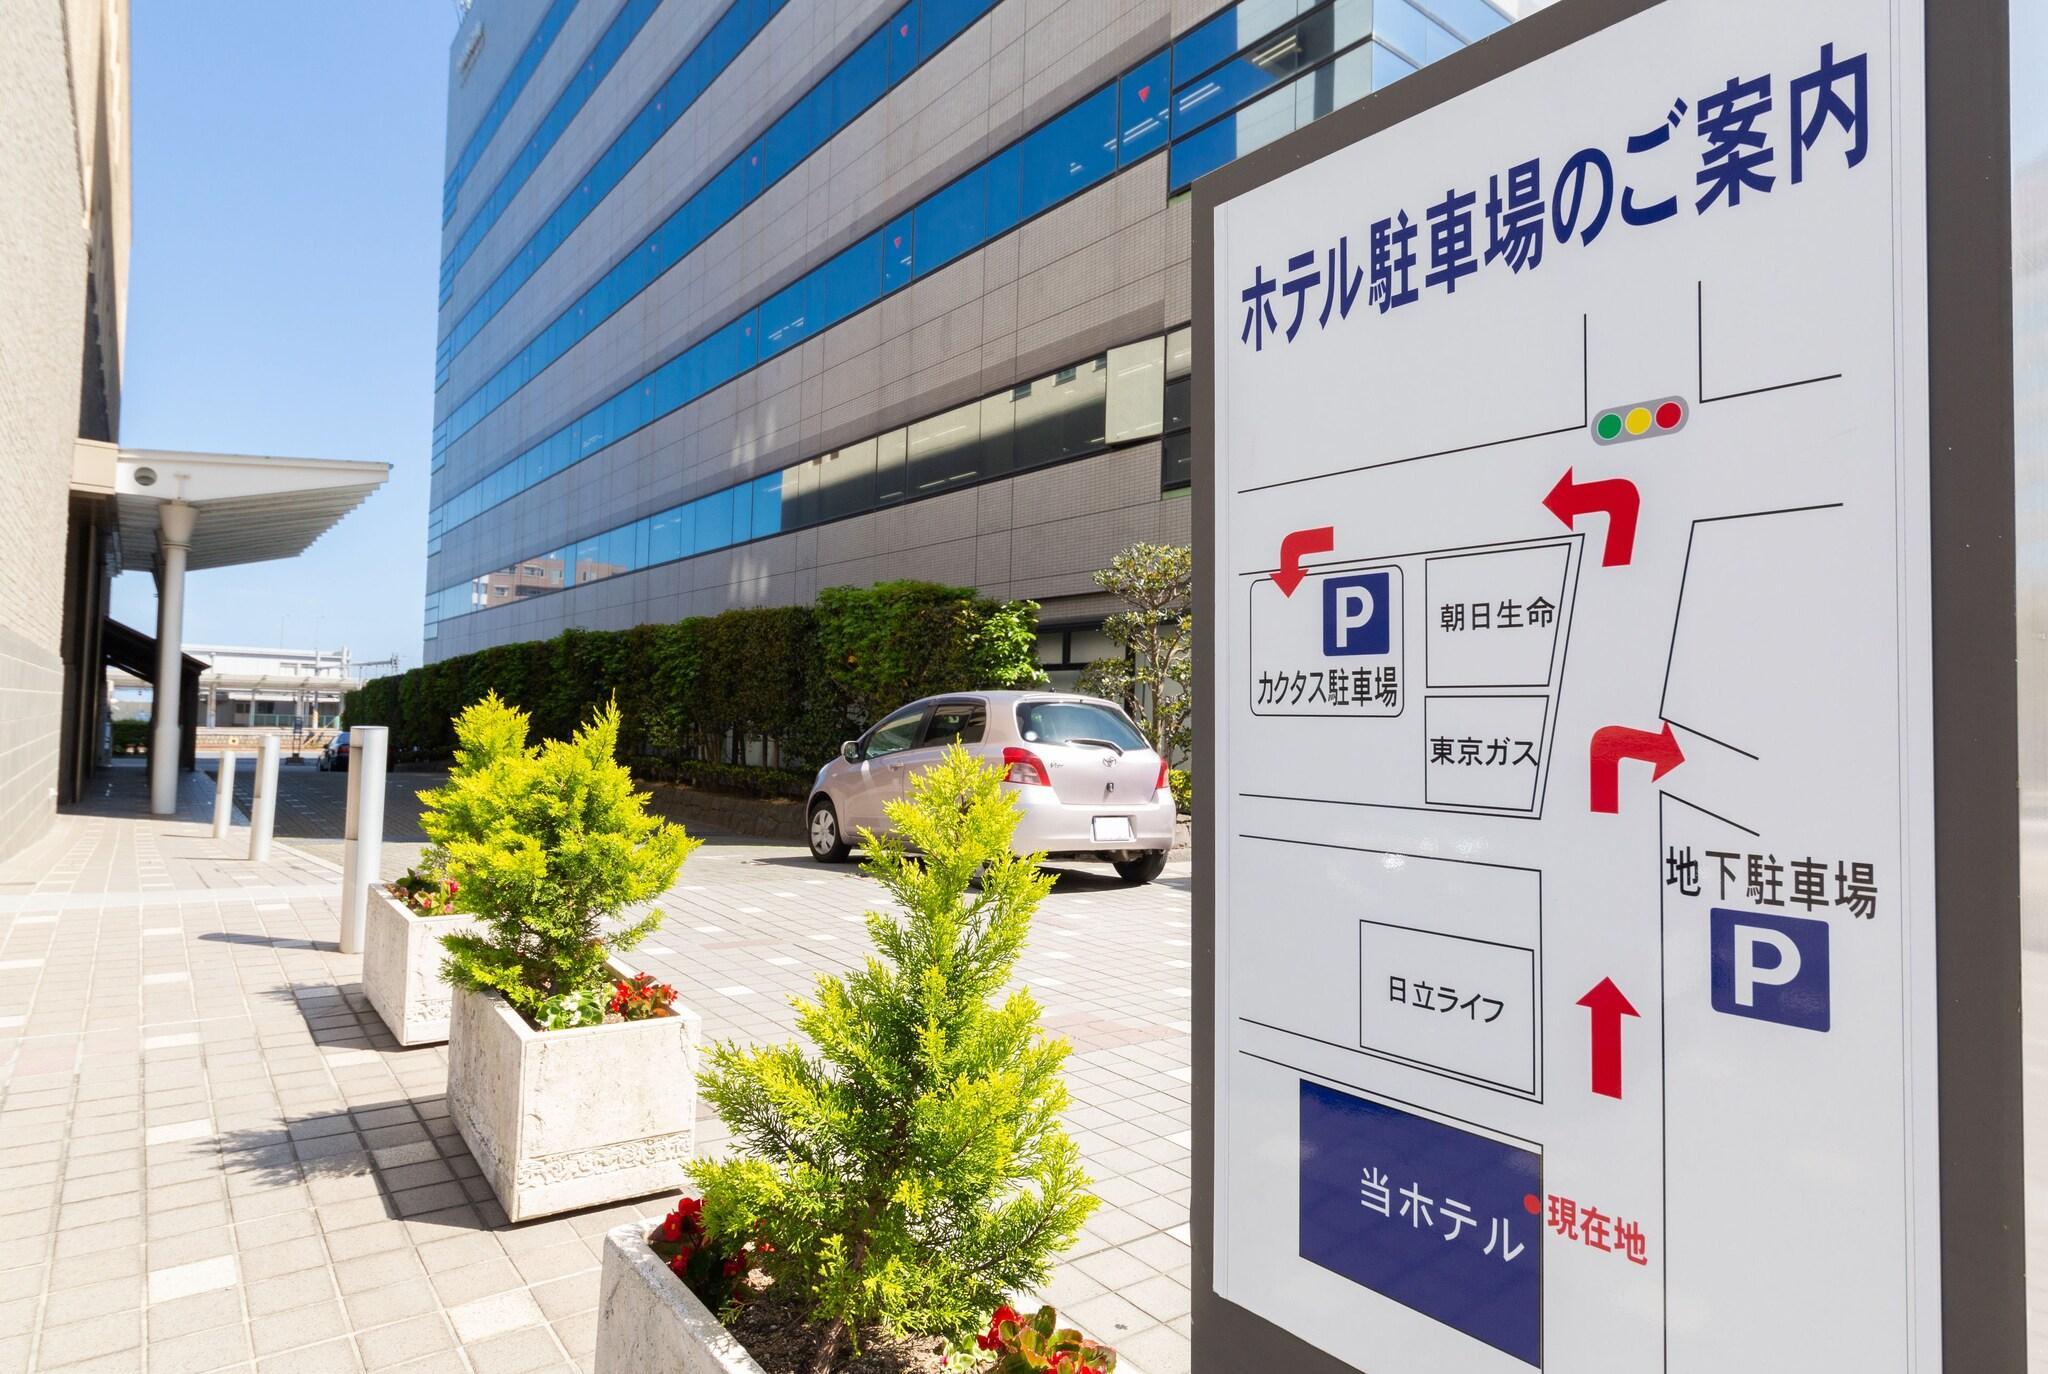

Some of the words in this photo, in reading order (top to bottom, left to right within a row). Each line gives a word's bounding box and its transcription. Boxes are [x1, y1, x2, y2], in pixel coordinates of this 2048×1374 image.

[1241, 42, 1869, 352] ホテル駐車場のご案内
[1336, 586, 1374, 648] P
[1440, 596, 1556, 632] 朝日生命
[1257, 666, 1398, 708] カクタス駐車場
[1429, 736, 1539, 767] 東京ガス
[1665, 845, 1878, 920] 地下駐車場
[1733, 923, 1802, 1008] P
[1389, 976, 1505, 1024] 日立ライフ
[1360, 1167, 1526, 1263] 当ホテル
[1547, 1194, 1648, 1265] 現在地
